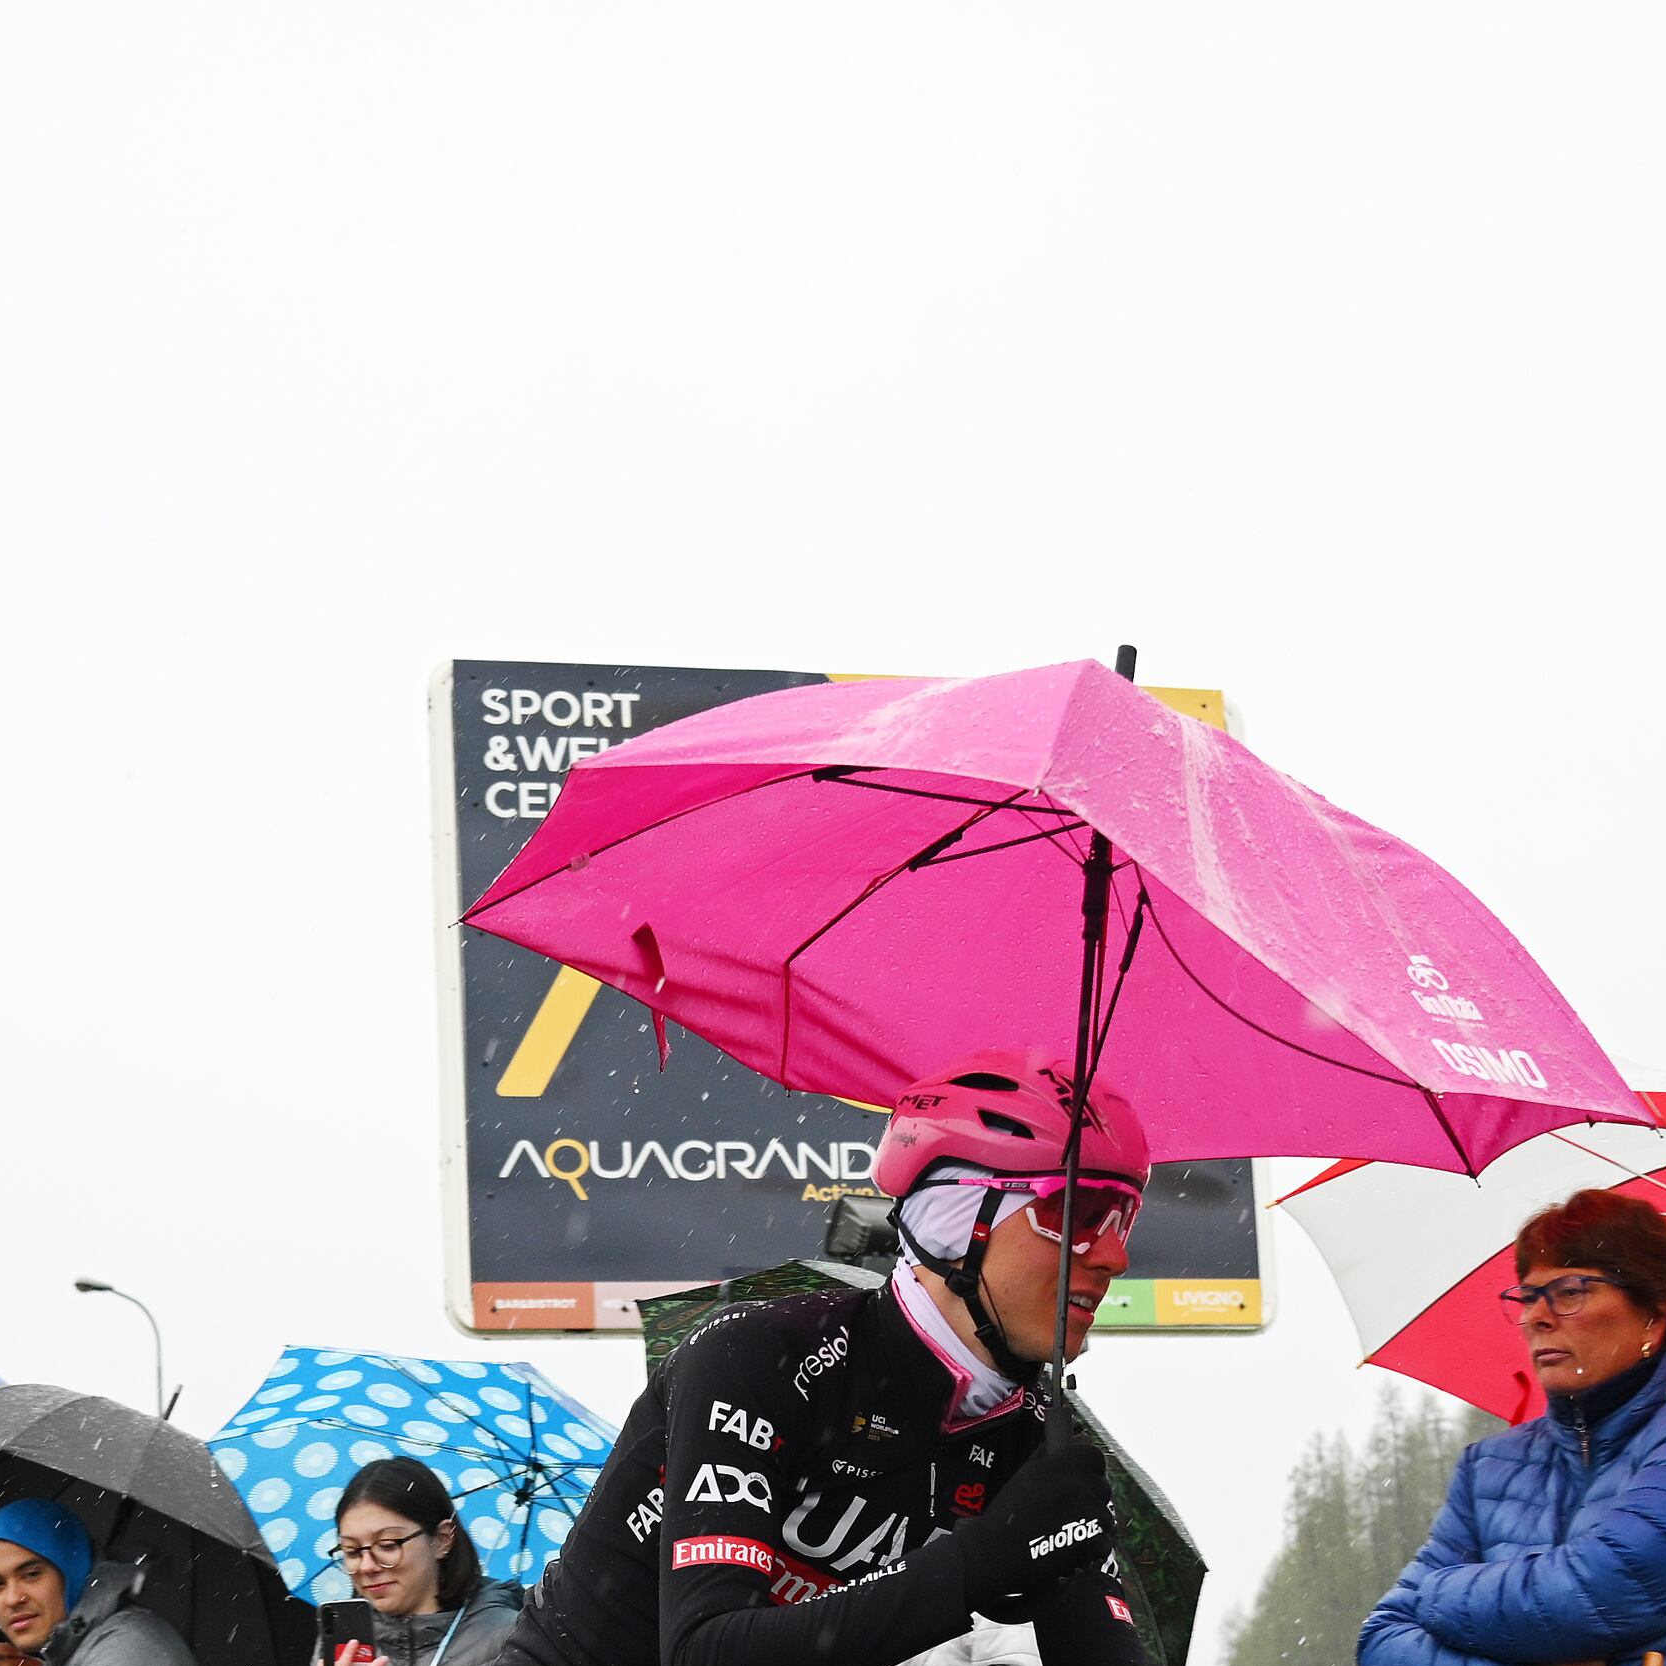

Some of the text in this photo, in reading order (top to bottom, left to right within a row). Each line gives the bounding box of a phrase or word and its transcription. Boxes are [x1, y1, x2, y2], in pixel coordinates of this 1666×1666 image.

[481, 688, 641, 728] SPORT
[1431, 1038, 1548, 1089] OSIMO
[899, 1094, 947, 1111] MET
[499, 1137, 876, 1201] AQUAGRAND
[708, 1400, 774, 1451] FAB
[871, 1414, 886, 1425] UCI
[675, 1537, 773, 1572] Emirates
[859, 1560, 907, 1586] MILLE
